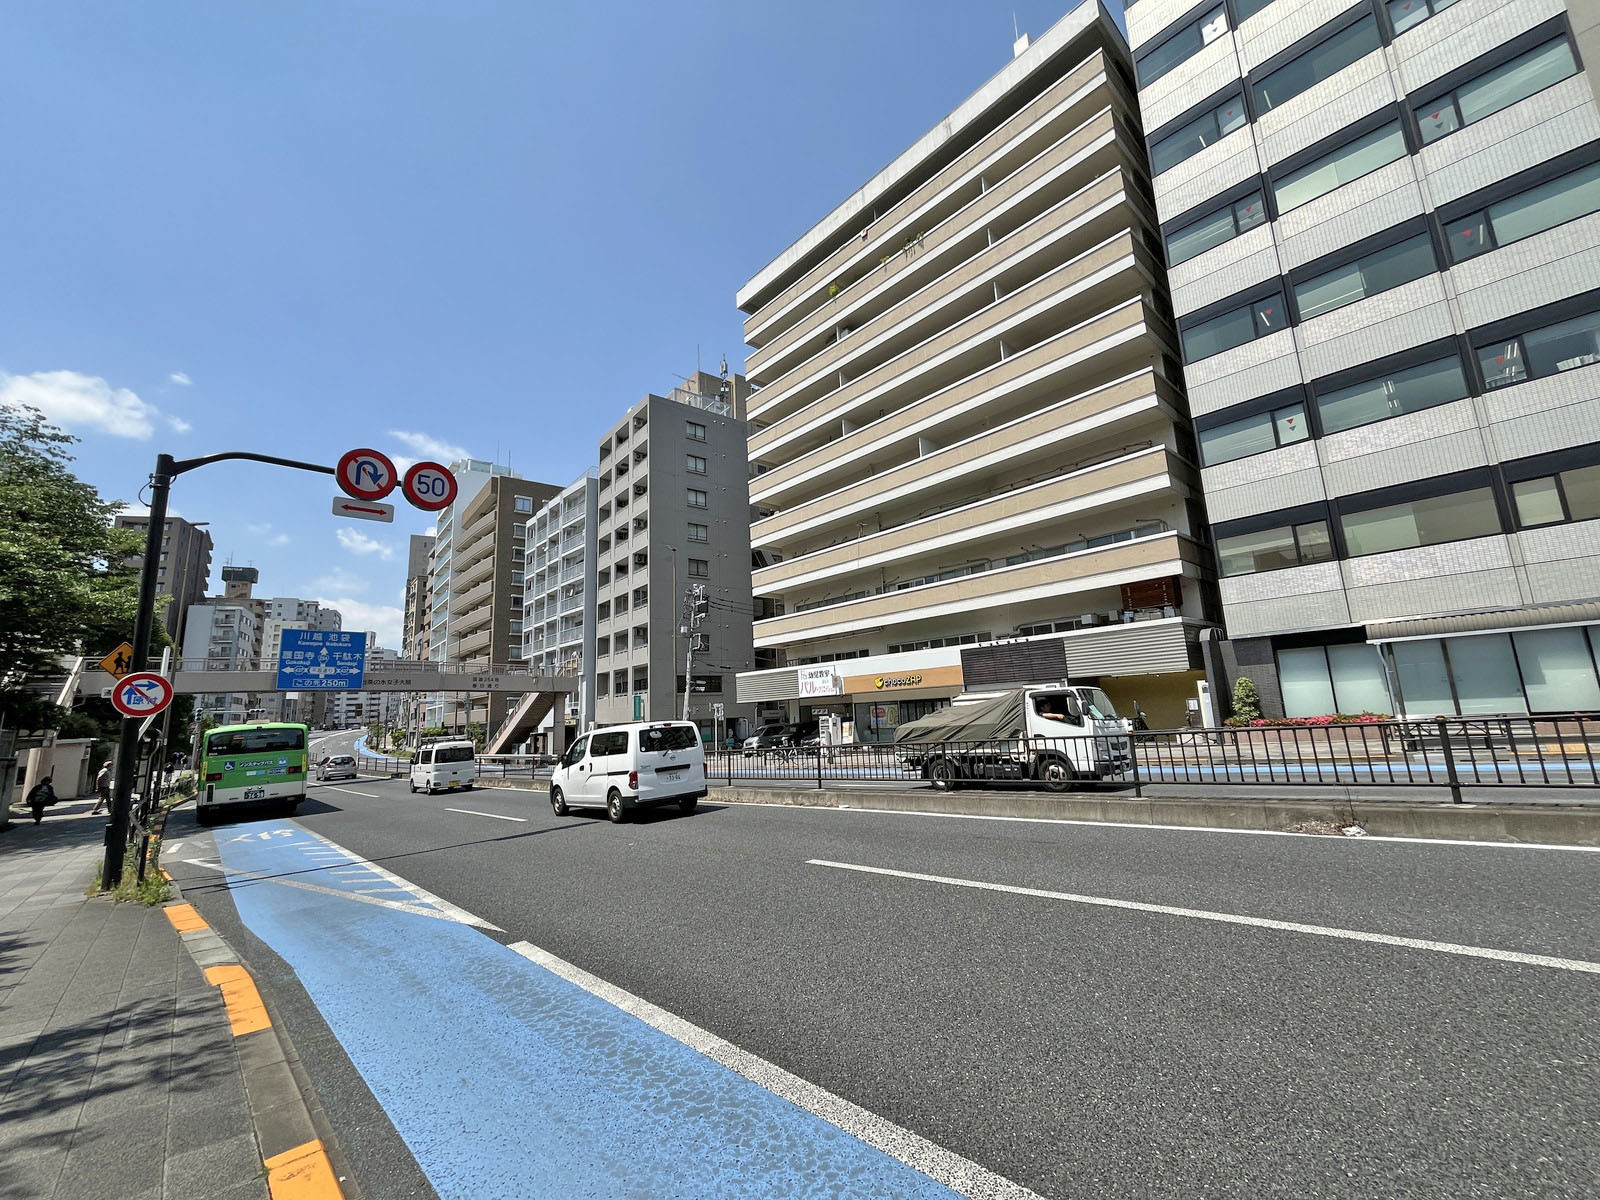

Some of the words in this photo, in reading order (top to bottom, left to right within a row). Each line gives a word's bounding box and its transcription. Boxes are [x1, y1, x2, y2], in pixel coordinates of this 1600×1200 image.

[417, 474, 445, 497] 50
[299, 631, 323, 641] 川越
[329, 633, 351, 642] 池袋
[332, 652, 363, 661] 千駄木
[883, 674, 921, 686] chocoZAP
